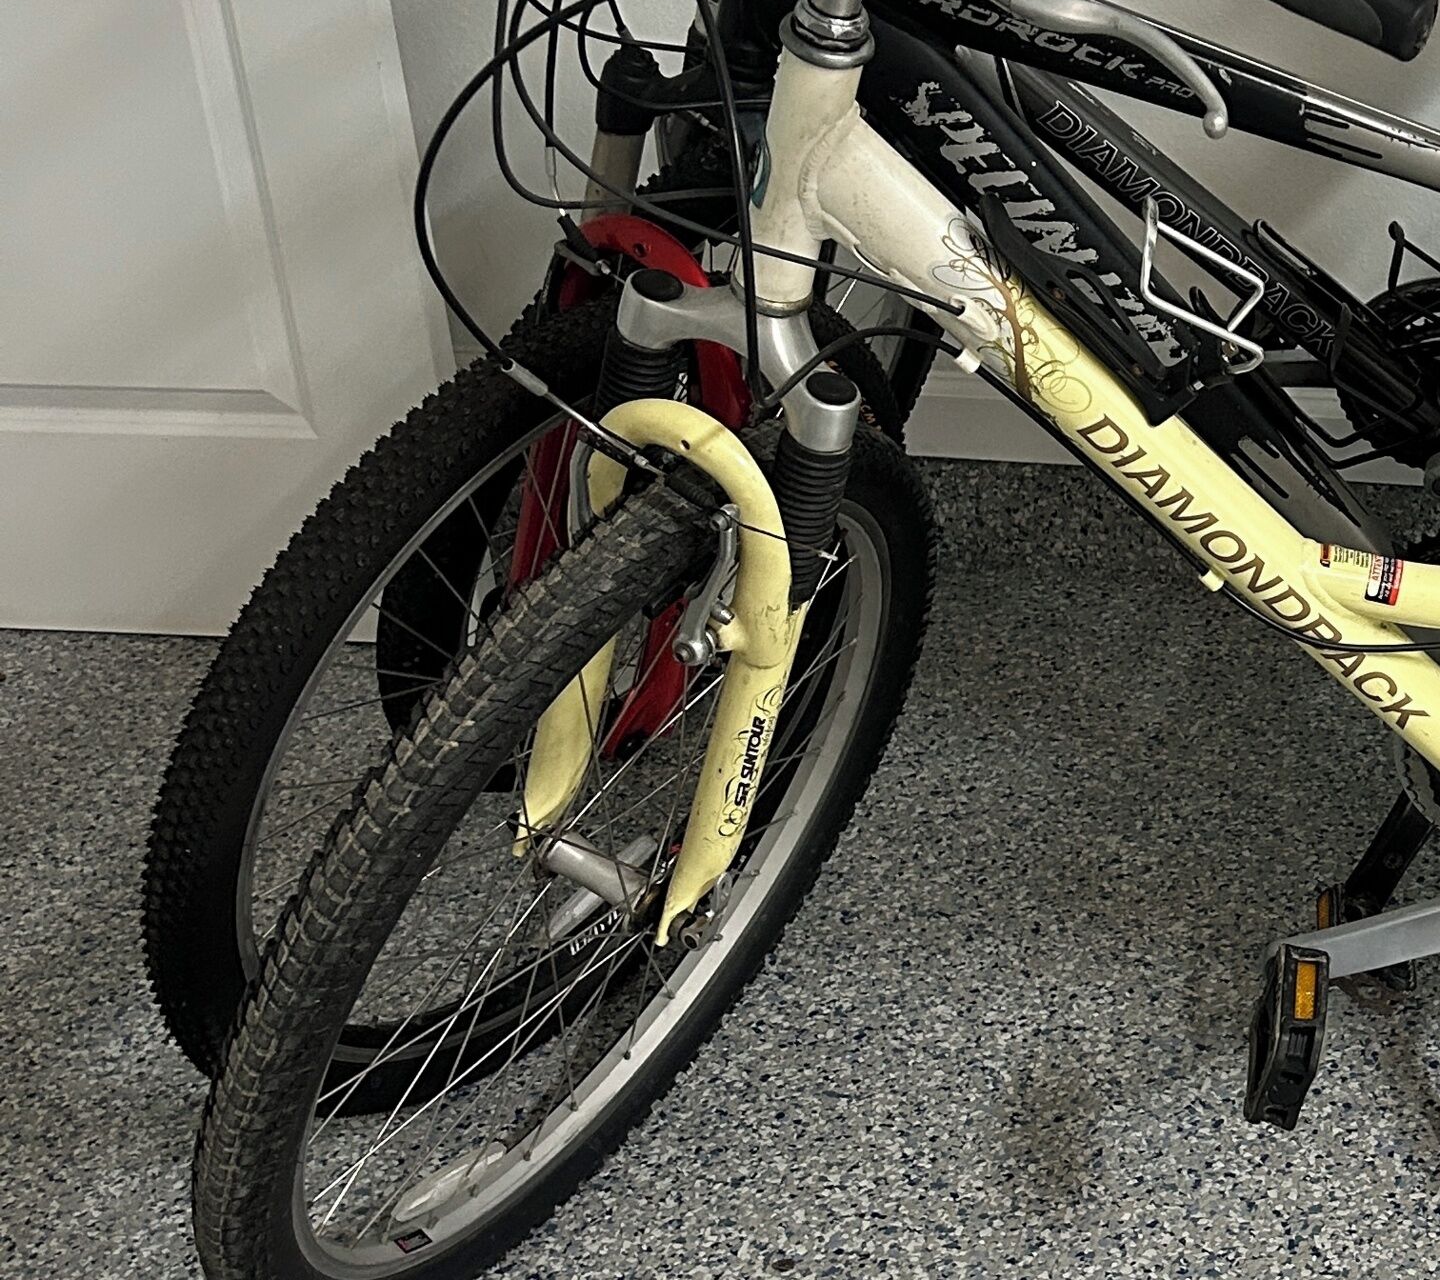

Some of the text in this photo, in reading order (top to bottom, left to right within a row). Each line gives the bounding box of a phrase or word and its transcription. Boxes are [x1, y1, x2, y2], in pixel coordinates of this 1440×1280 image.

[1146, 76, 1196, 100] PRO
[1077, 413, 1431, 730] DIAMONDBACK
[734, 716, 767, 808] SR SUNTOUR
